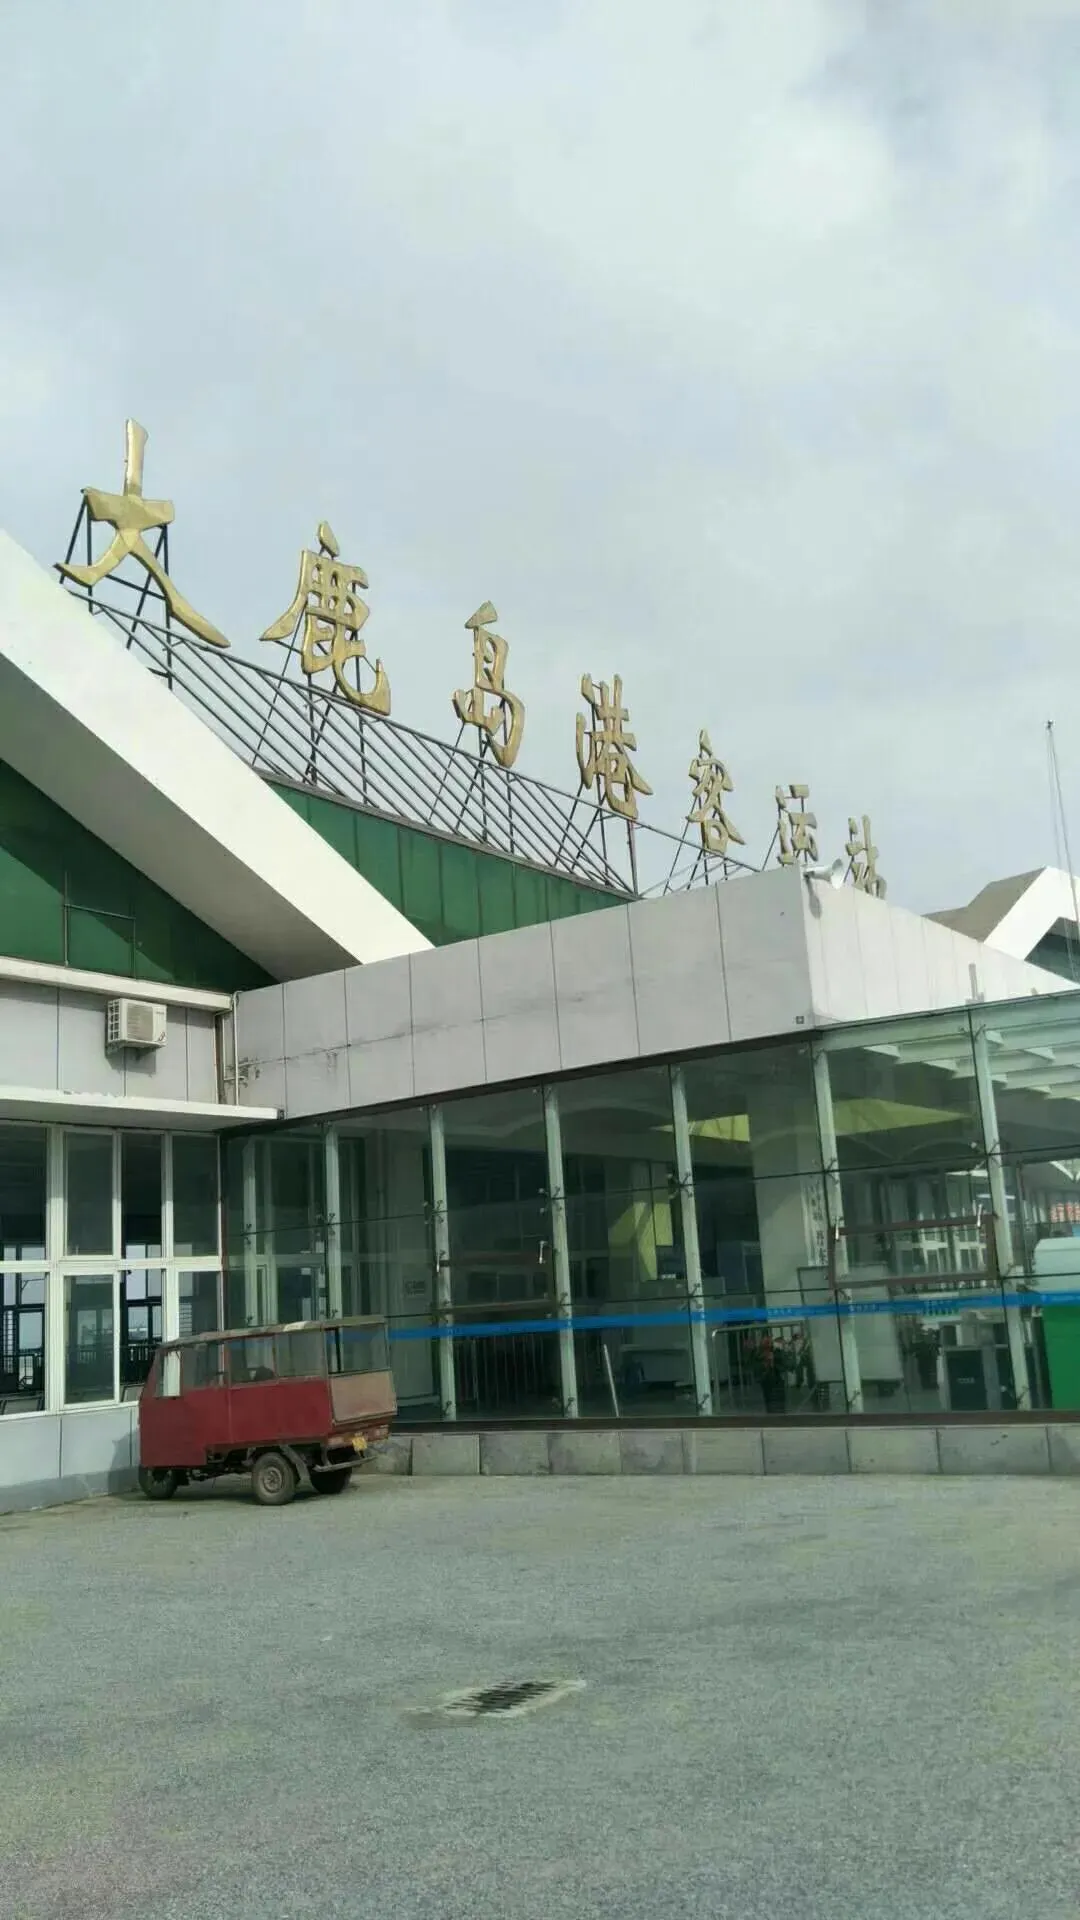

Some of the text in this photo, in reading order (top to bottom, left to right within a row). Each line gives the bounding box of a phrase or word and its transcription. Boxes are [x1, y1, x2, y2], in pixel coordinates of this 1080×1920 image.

[54, 418, 887, 900] 大鹿岛港客运站
